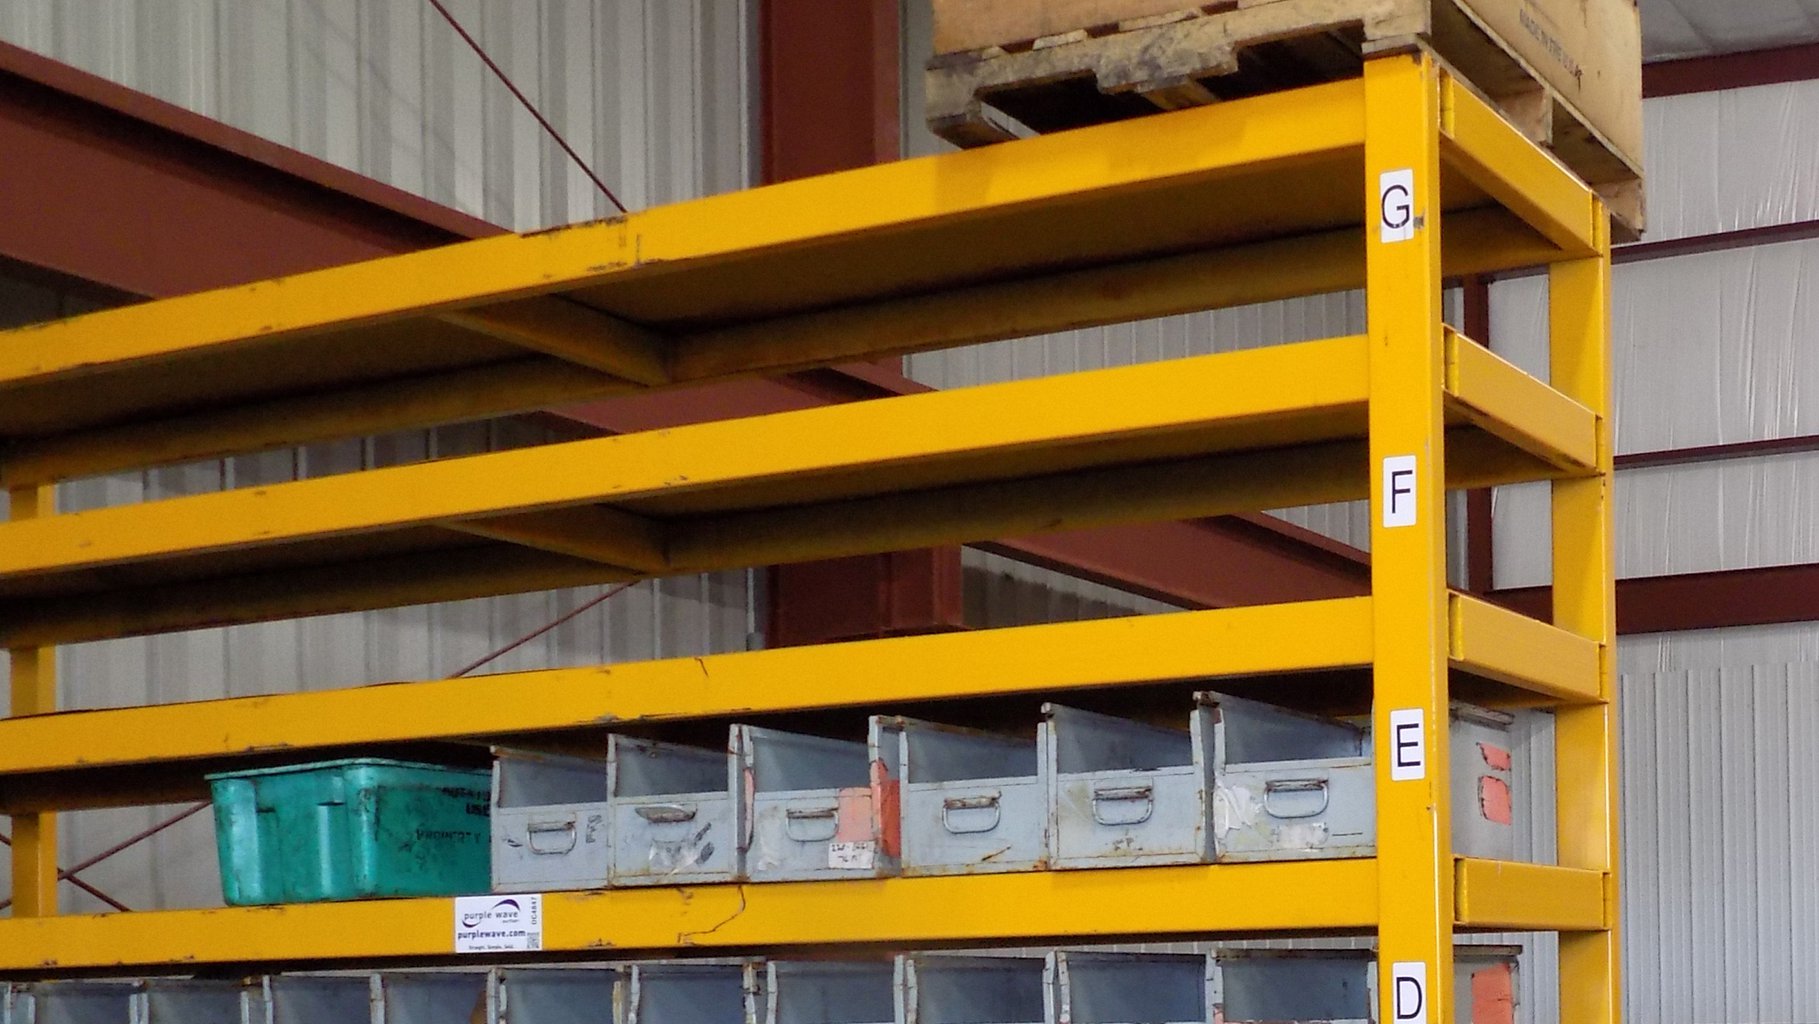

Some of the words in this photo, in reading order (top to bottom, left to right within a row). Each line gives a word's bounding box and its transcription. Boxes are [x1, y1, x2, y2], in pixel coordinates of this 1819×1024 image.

[1381, 184, 1410, 229] G
[1391, 469, 1413, 514] F
[1395, 723, 1422, 767] E
[458, 930, 526, 940] purplewave.com
[464, 911, 492, 921] purple
[495, 911, 519, 919] wave
[1396, 976, 1423, 1020] D
